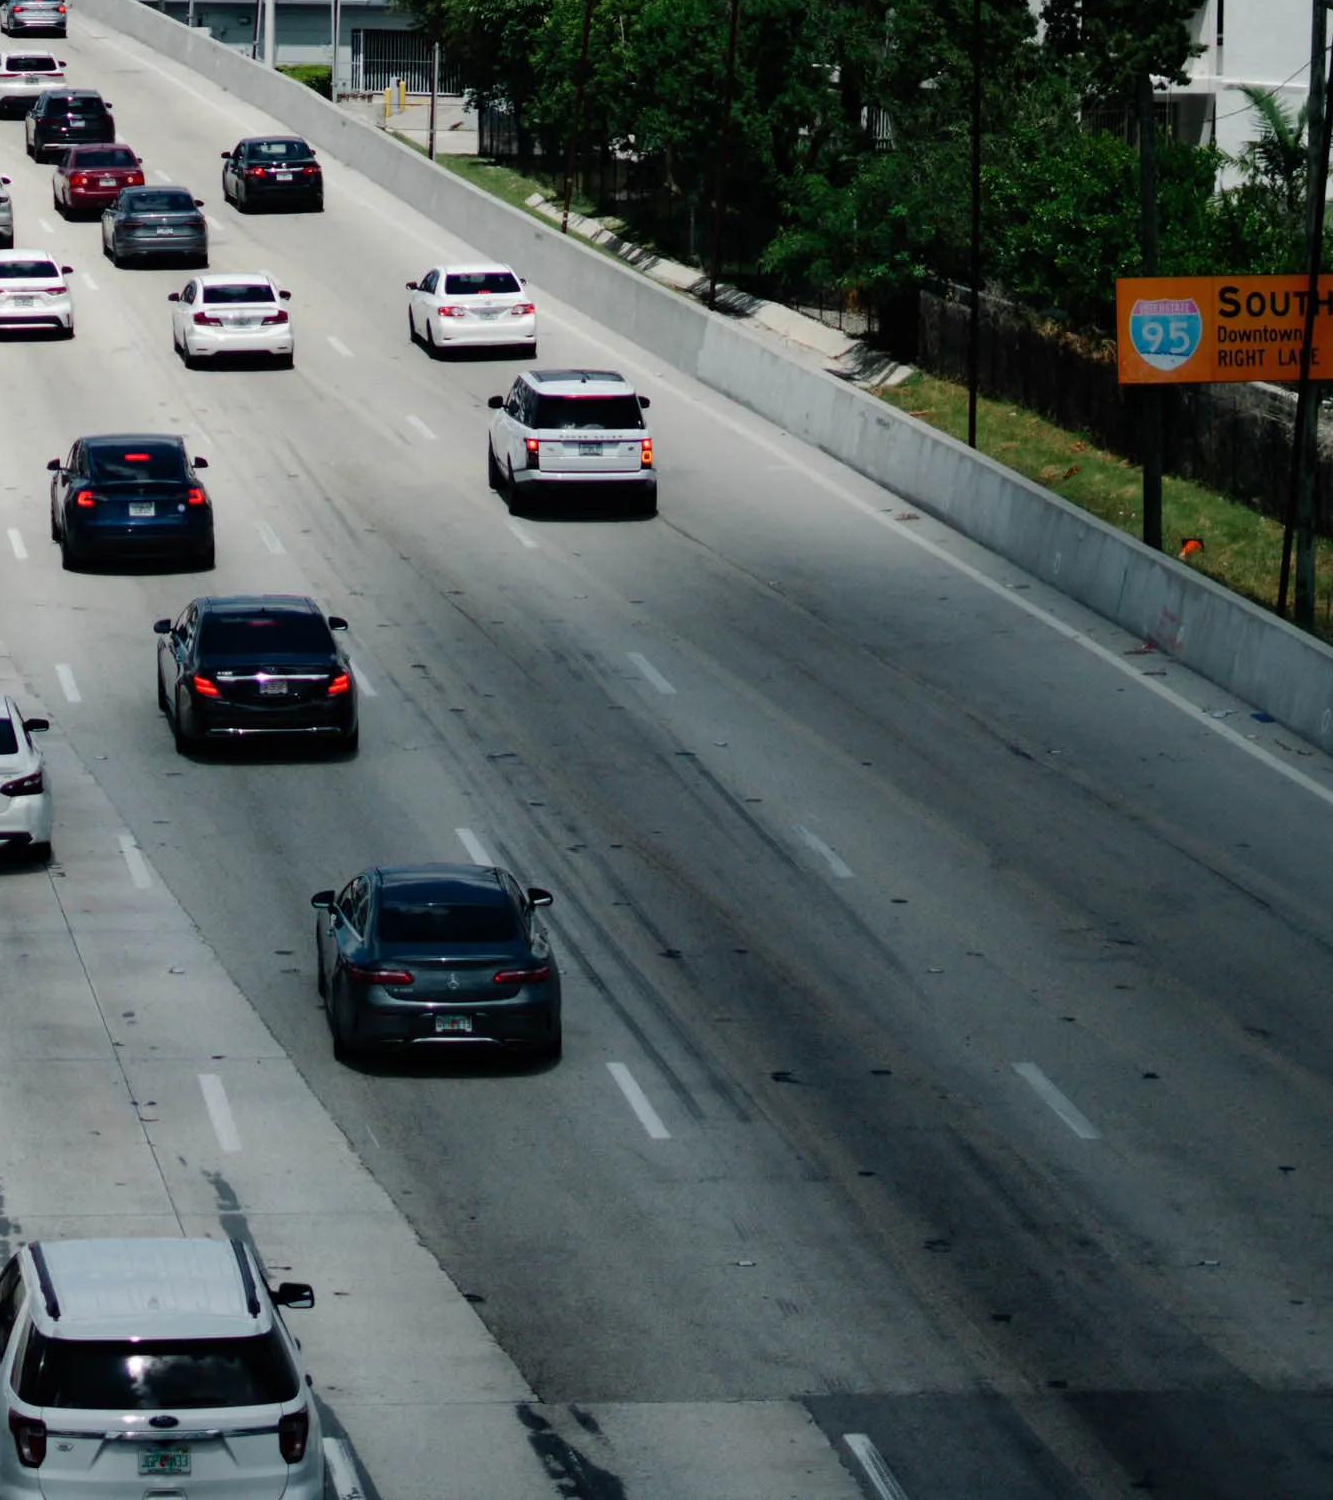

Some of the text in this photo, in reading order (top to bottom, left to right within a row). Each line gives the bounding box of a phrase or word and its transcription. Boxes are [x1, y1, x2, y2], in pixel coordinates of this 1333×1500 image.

[1219, 286, 1333, 318] SOUTH
[1142, 321, 1191, 355] 95
[1218, 324, 1303, 344] Downtown
[1218, 347, 1319, 367] RIGHT LAE
